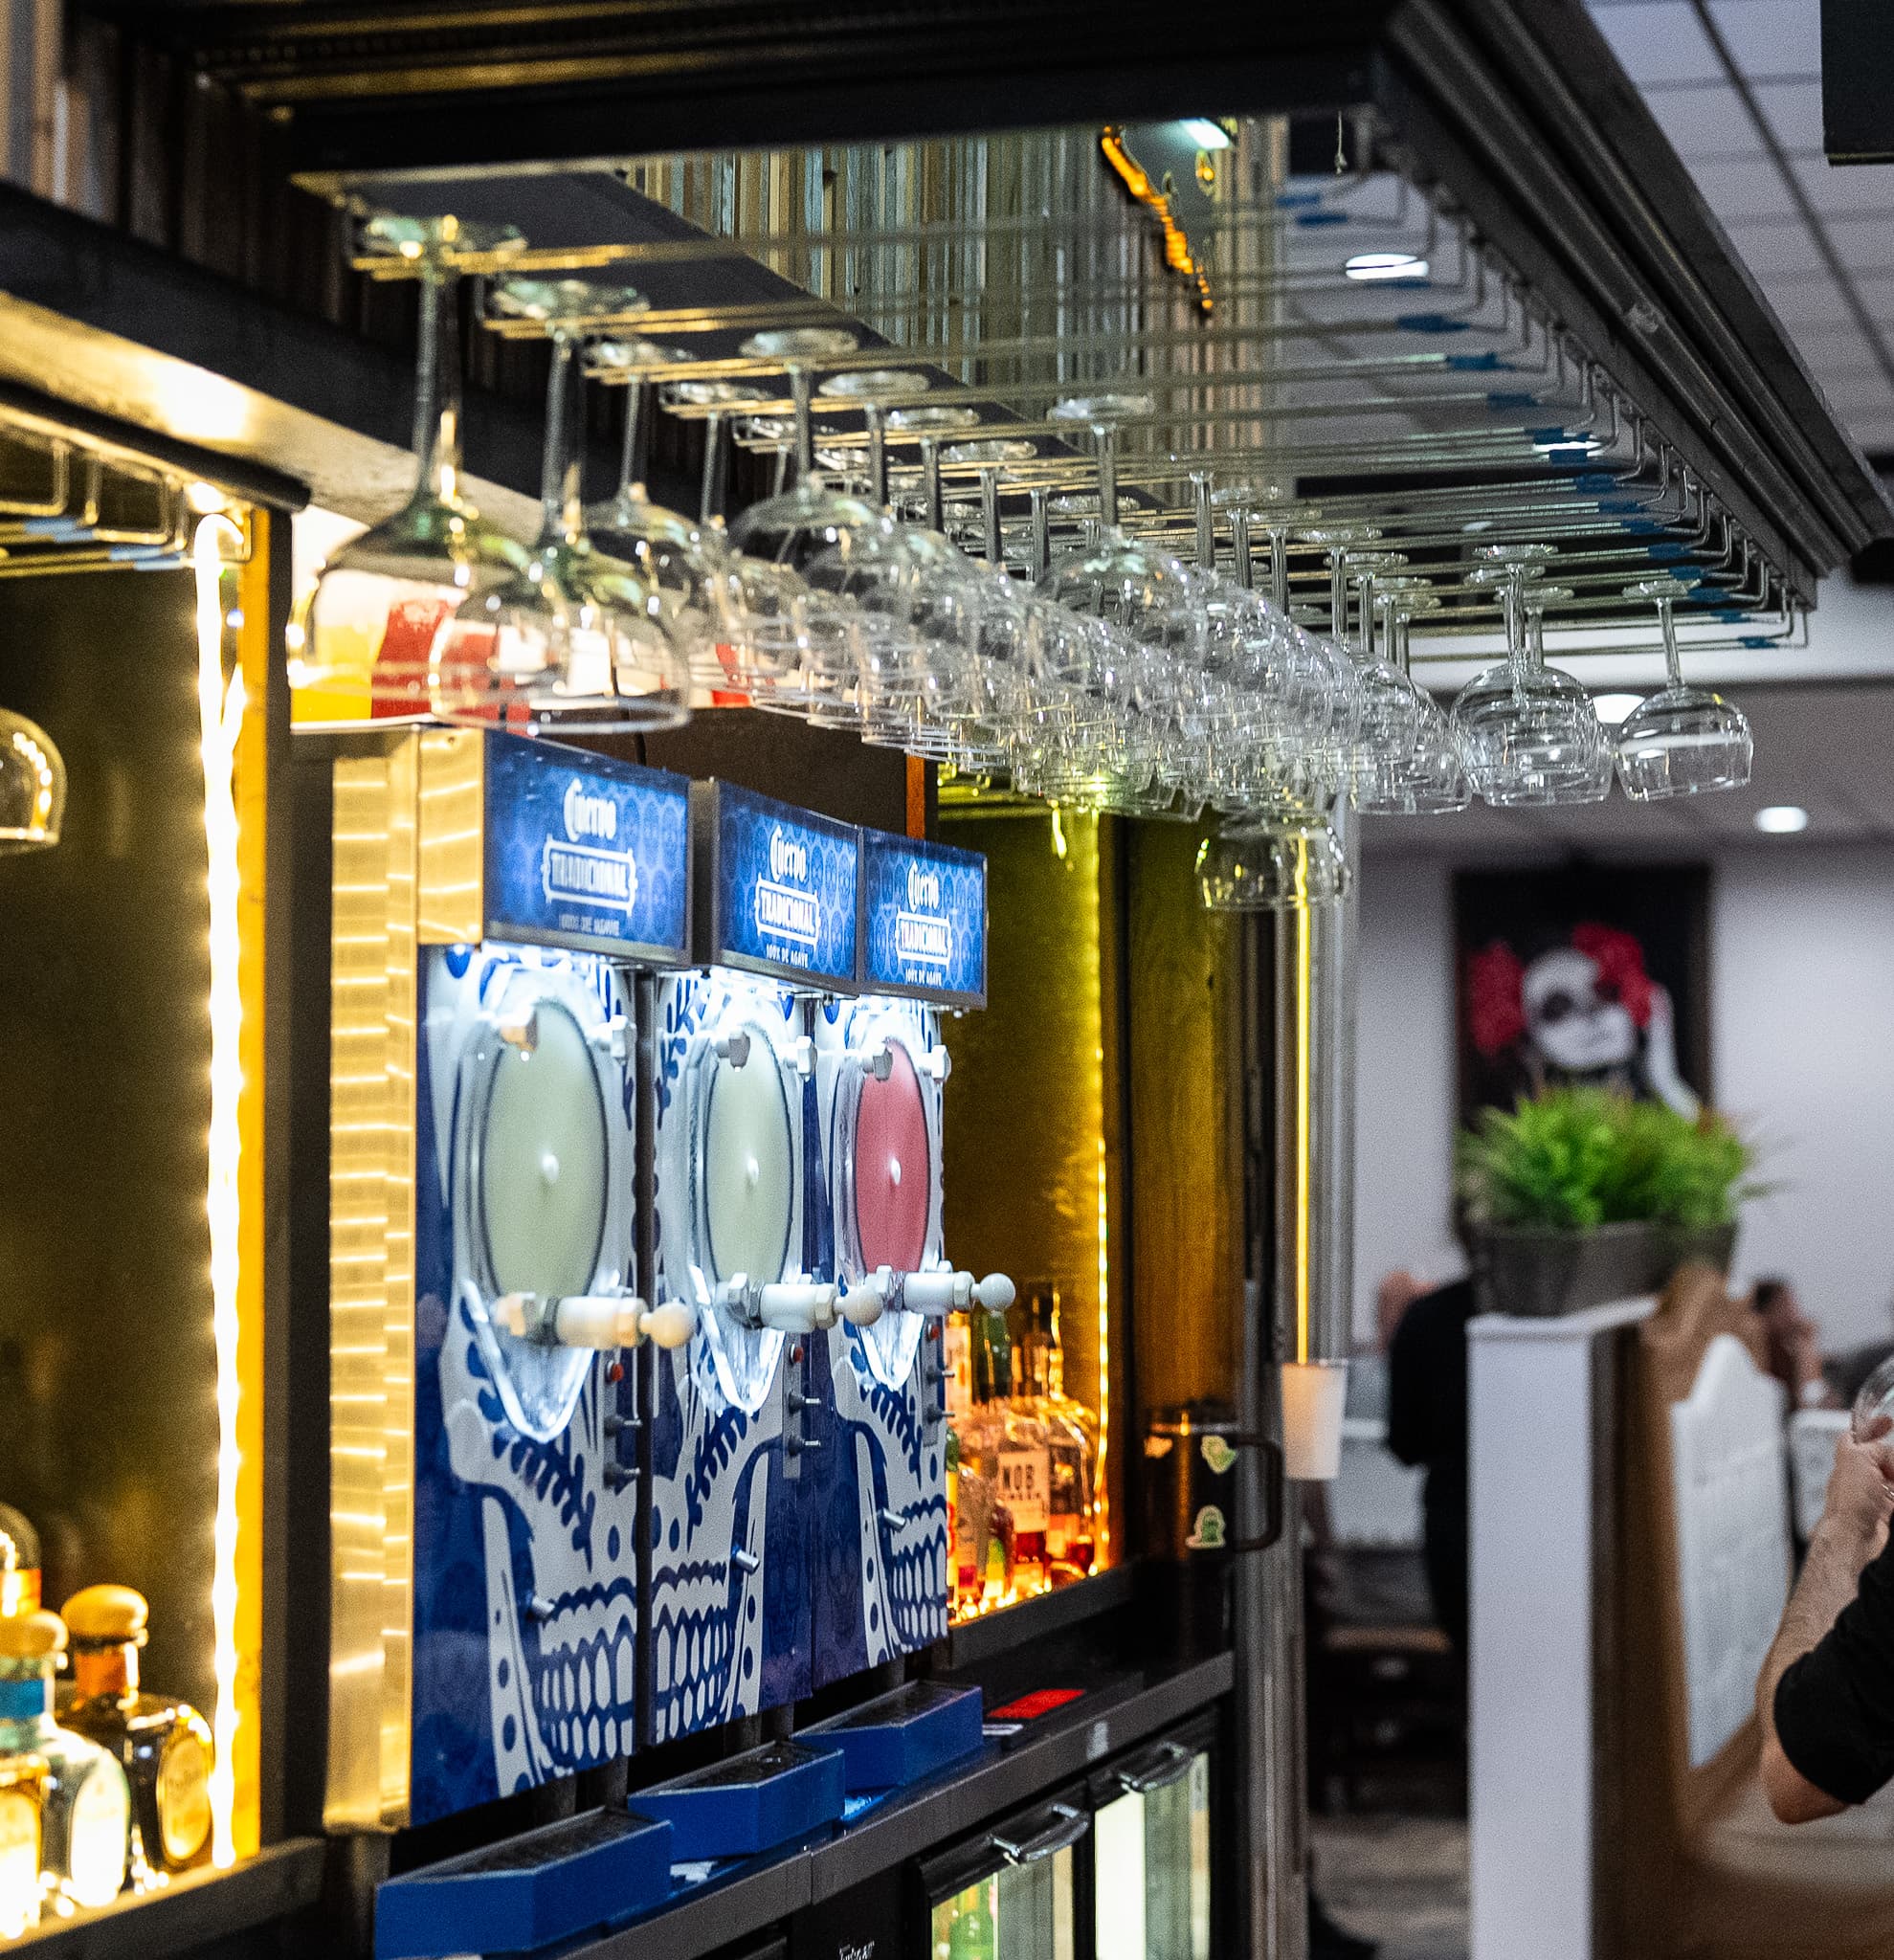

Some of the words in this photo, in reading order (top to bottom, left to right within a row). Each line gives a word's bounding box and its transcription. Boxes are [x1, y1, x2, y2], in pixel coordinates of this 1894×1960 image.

[769, 824, 807, 882] Cuervo
[761, 888, 816, 936] TRADICIONAL
[907, 859, 940, 913] Cuervo
